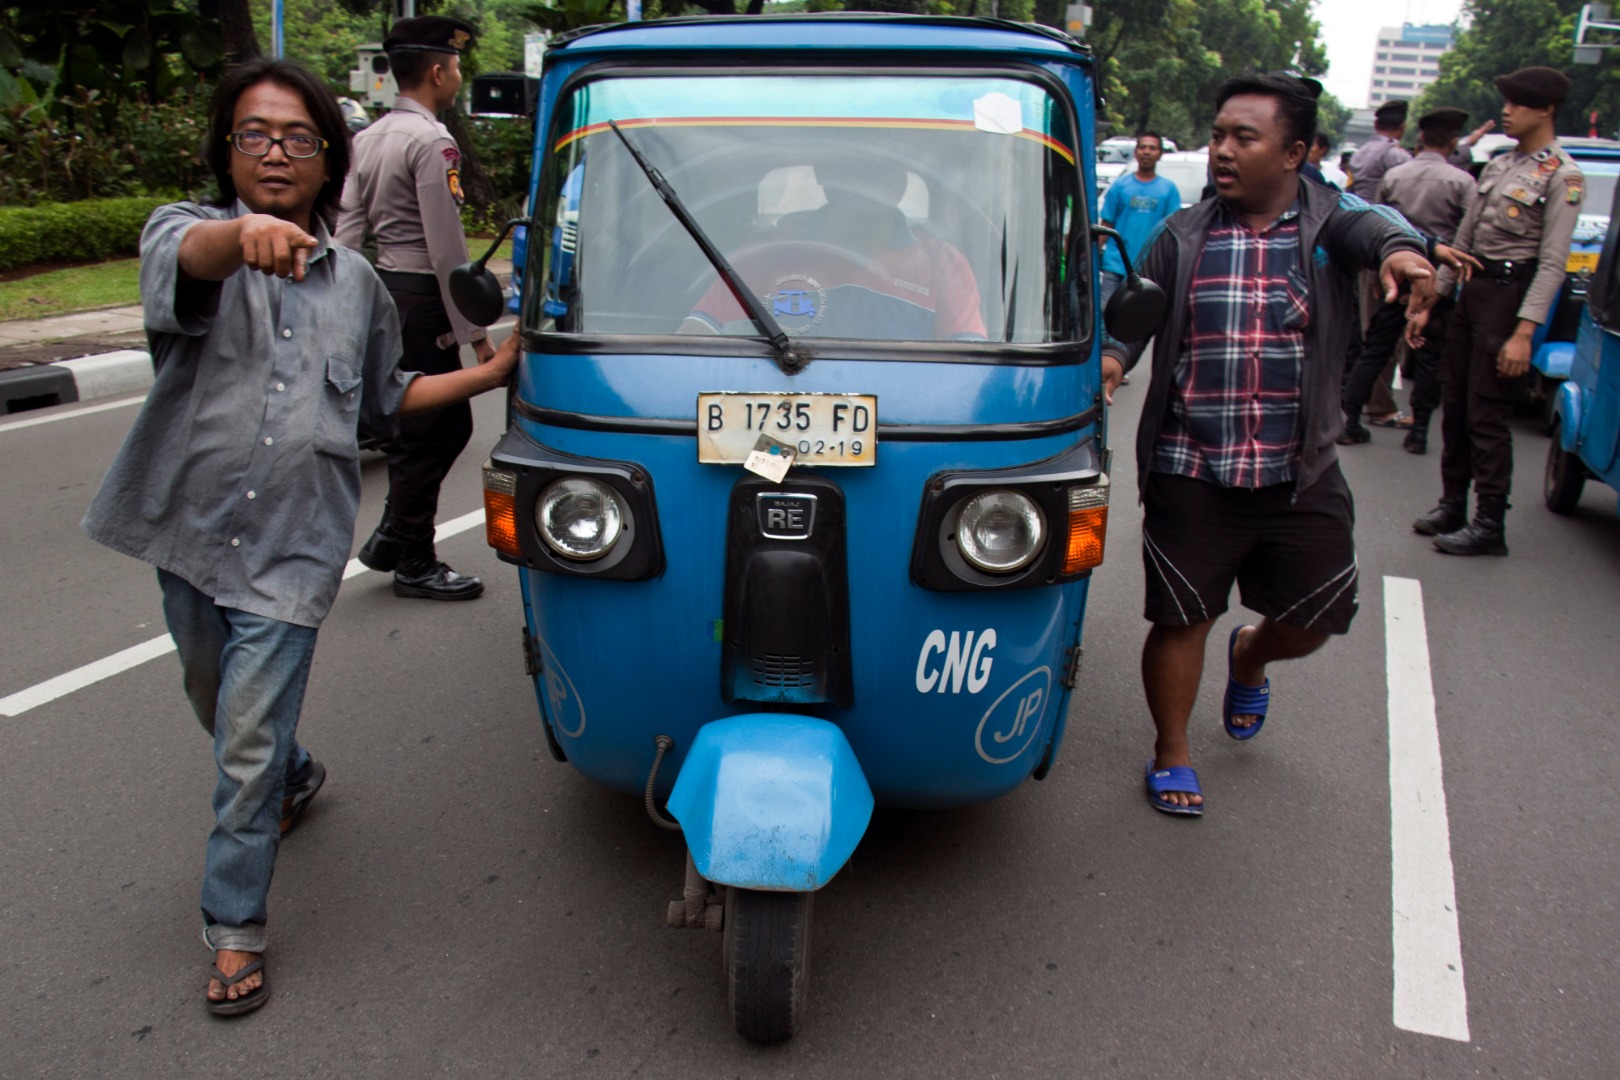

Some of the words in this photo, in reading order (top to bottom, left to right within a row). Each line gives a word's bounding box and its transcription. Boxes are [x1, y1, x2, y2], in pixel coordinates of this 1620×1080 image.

[707, 403, 724, 431] B
[745, 402, 811, 431] 1735
[832, 404, 870, 432] FD
[767, 508, 805, 530] RE
[915, 627, 998, 695] CNG
[993, 687, 1044, 744] JP
